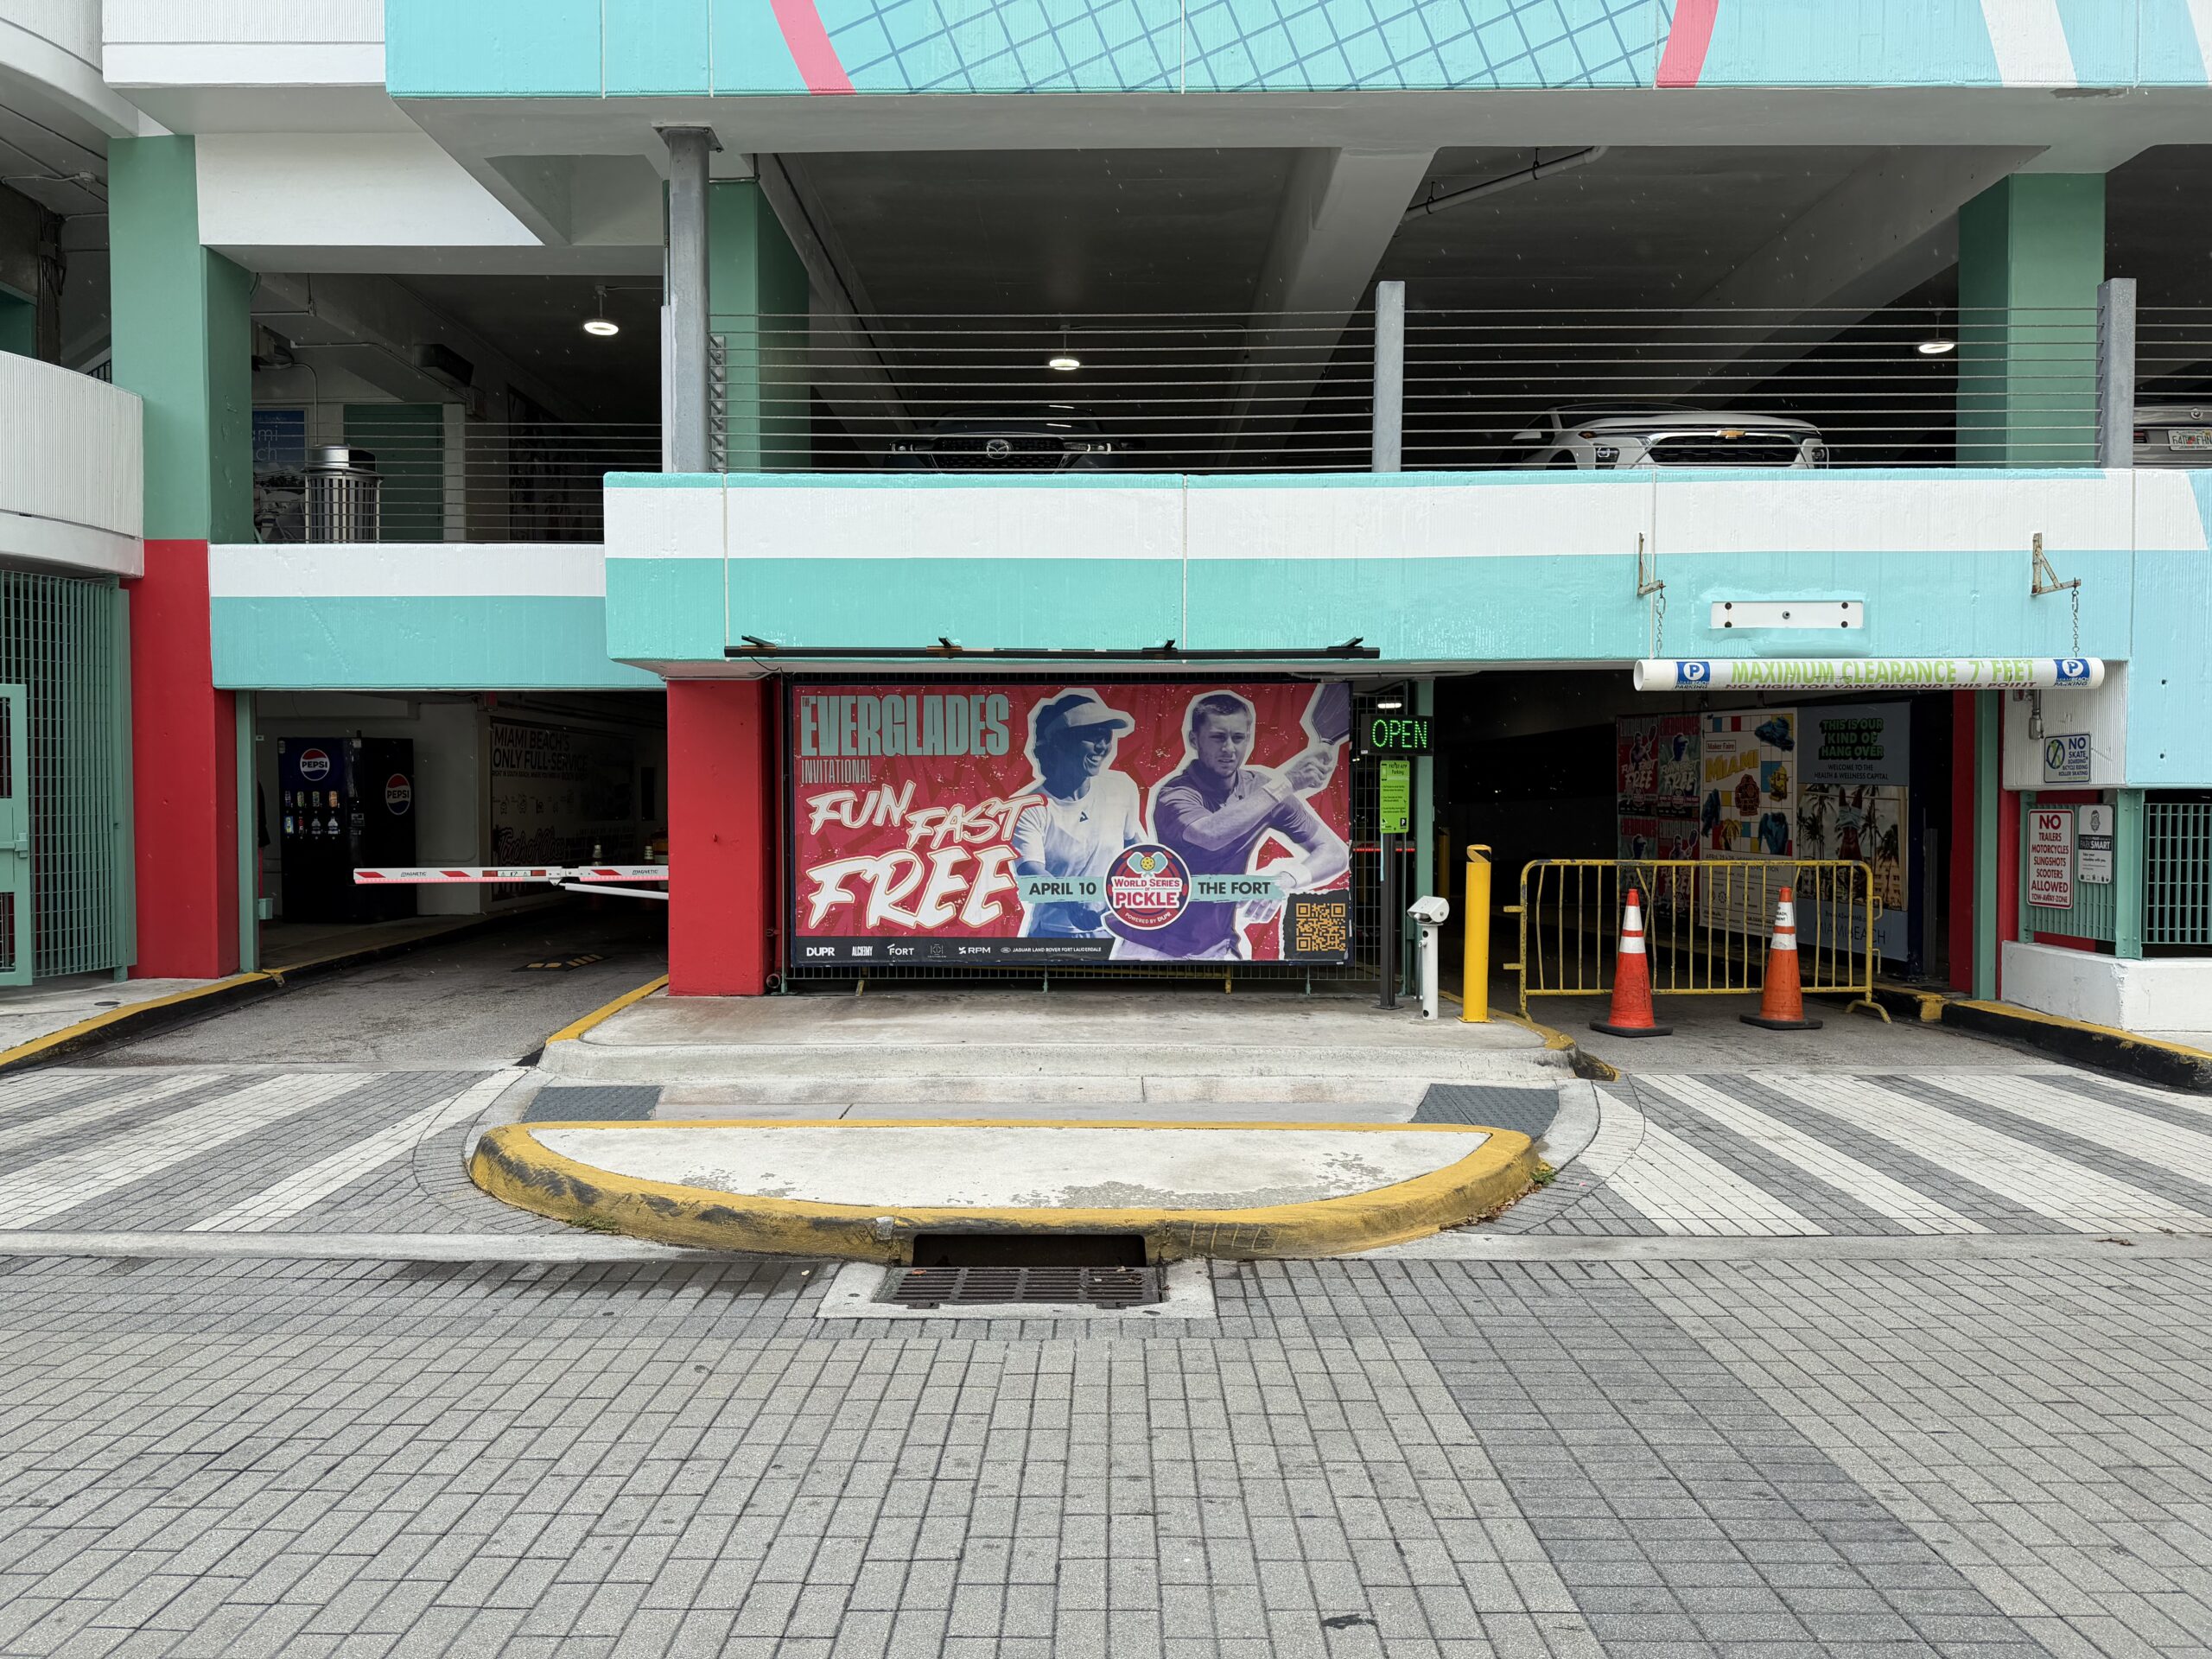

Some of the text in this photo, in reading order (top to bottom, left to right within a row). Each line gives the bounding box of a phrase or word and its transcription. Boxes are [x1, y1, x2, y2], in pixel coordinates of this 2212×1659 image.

[1731, 661, 1834, 683] MAXIMUM
[1841, 660, 1956, 683] CLEARANCE
[1992, 659, 2033, 683] FEET
[801, 694, 1009, 757] EVERGLADES
[1823, 718, 1884, 732] THIS IS OUR
[494, 727, 570, 751] MIAMI BEACH'S
[1371, 719, 1427, 749] OPEN
[1827, 732, 1878, 745] KIND OF
[1707, 741, 1735, 750] Maker Faire
[2069, 737, 2087, 750] NO
[1821, 746, 1885, 758] HANG OVER
[493, 748, 588, 772] ONLY FULL-SERVICE
[1705, 749, 1759, 783] MIAMI
[801, 759, 872, 784] INVITATIONAL
[386, 790, 410, 799] PEPSI
[806, 779, 917, 836] FUN
[906, 792, 1048, 849] FAST
[2039, 814, 2062, 830] NO
[2038, 832, 2062, 842] TRAILERS
[2031, 844, 2069, 855] MOTORCYCLES
[2033, 855, 2067, 867] SLINGSHOTS
[2037, 868, 2063, 880] SCOOTERS
[805, 845, 1022, 930] FREE
[1028, 882, 1096, 895] APRIL 10
[1114, 878, 1180, 888] WORLD SERIES
[1198, 881, 1271, 894] THE FORT
[2031, 880, 2069, 893] ALLOWED
[1115, 892, 1177, 906] PICKLE
[2031, 893, 2068, 903] TOW-AWAY-ZONE
[1125, 912, 1149, 925] POWERED
[806, 947, 836, 957] DUPR
[887, 944, 914, 956] FORT
